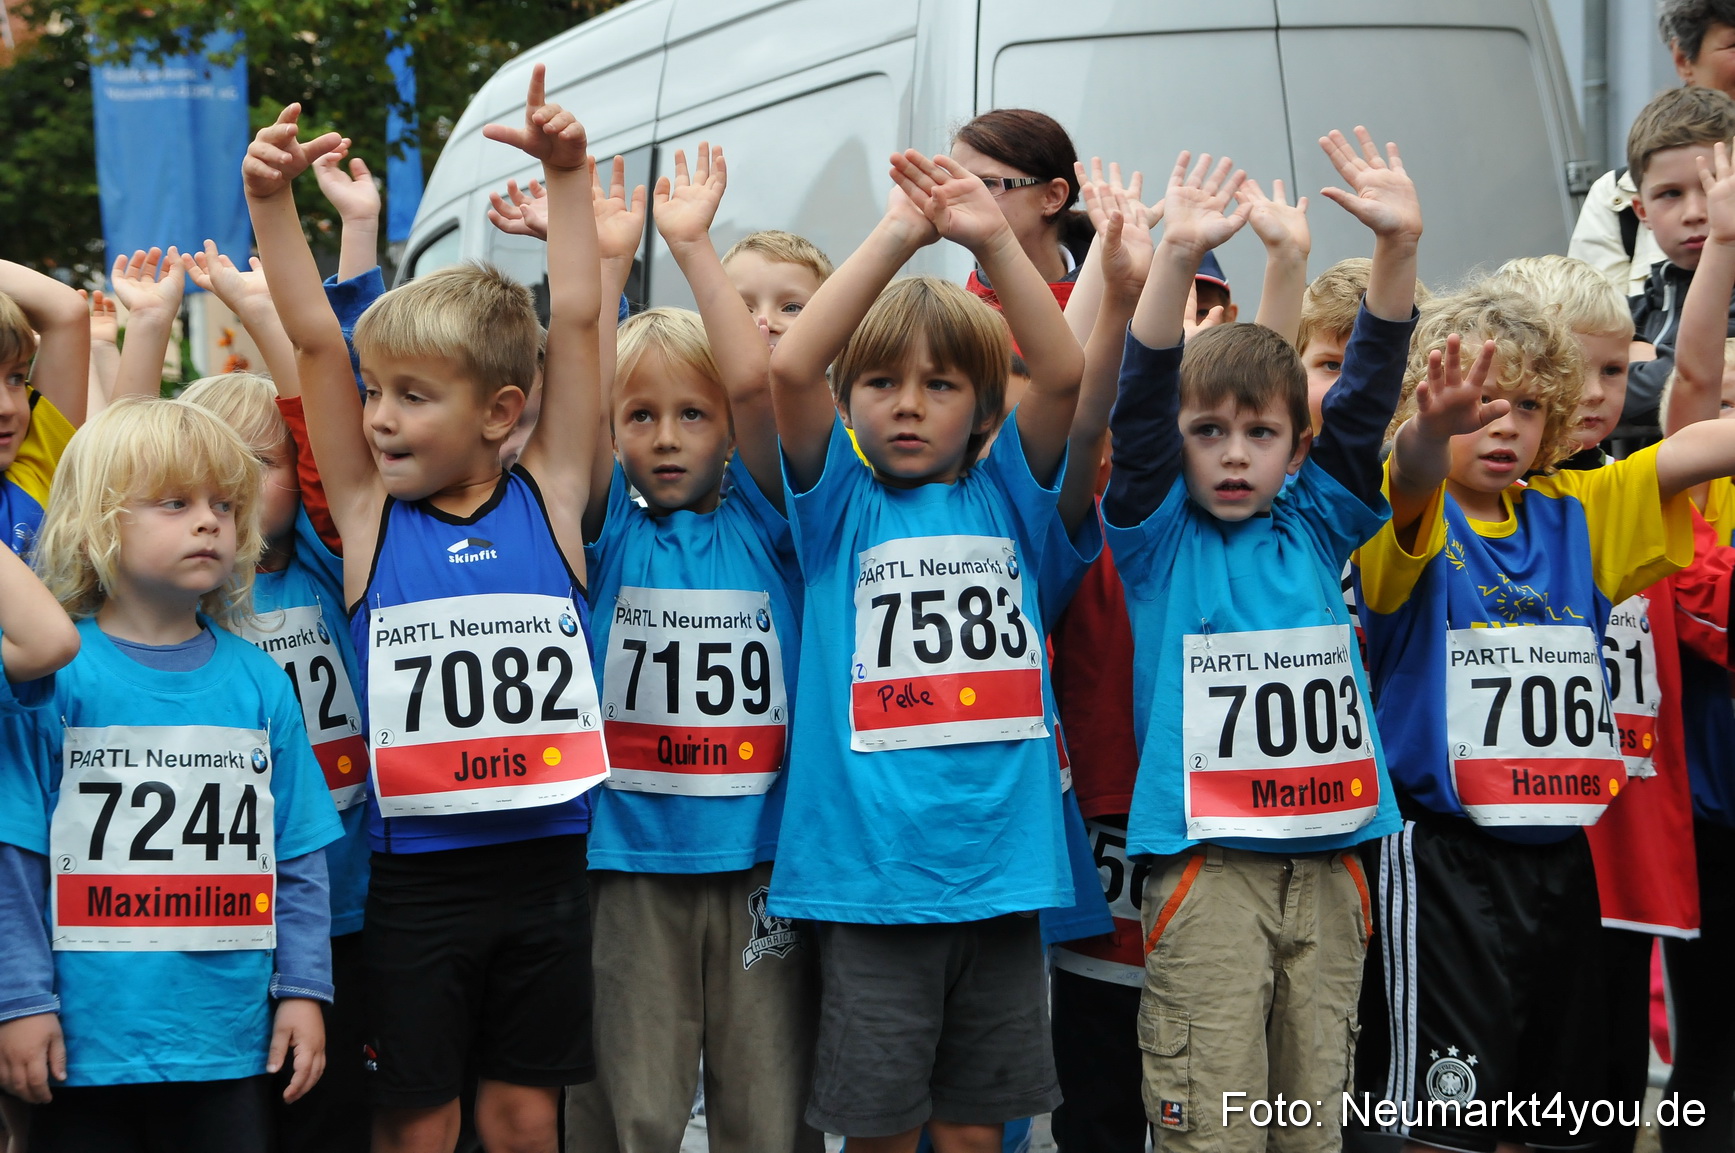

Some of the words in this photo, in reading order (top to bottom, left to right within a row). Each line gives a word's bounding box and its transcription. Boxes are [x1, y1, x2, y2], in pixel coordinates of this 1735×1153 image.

[448, 549, 498, 564] skinfit
[857, 560, 914, 589] PARTL
[919, 558, 1003, 577] Neumarkt
[375, 622, 444, 648] PARTL
[449, 615, 553, 638] Neumarkt
[615, 606, 658, 628] PARTL
[662, 610, 753, 629] Neumarkt
[871, 585, 1028, 669] 7583
[1608, 611, 1637, 628] arkt
[1190, 653, 1259, 674] PARTL
[1264, 645, 1347, 670] Neumarkt
[1451, 646, 1525, 667] PARTL
[394, 646, 579, 733] 7082
[622, 638, 771, 716] 7159
[877, 682, 934, 712] Pelle
[1471, 675, 1614, 748] 7064
[1208, 675, 1363, 759] 7003
[70, 748, 138, 769] PARTL
[146, 749, 245, 769] Neumarkt
[454, 747, 528, 782] Joris
[657, 734, 728, 766] Quirin
[1251, 777, 1345, 809] Marlon
[1511, 768, 1600, 796] Hannes
[78, 781, 261, 861] 7244
[87, 885, 252, 918] Maximilian
